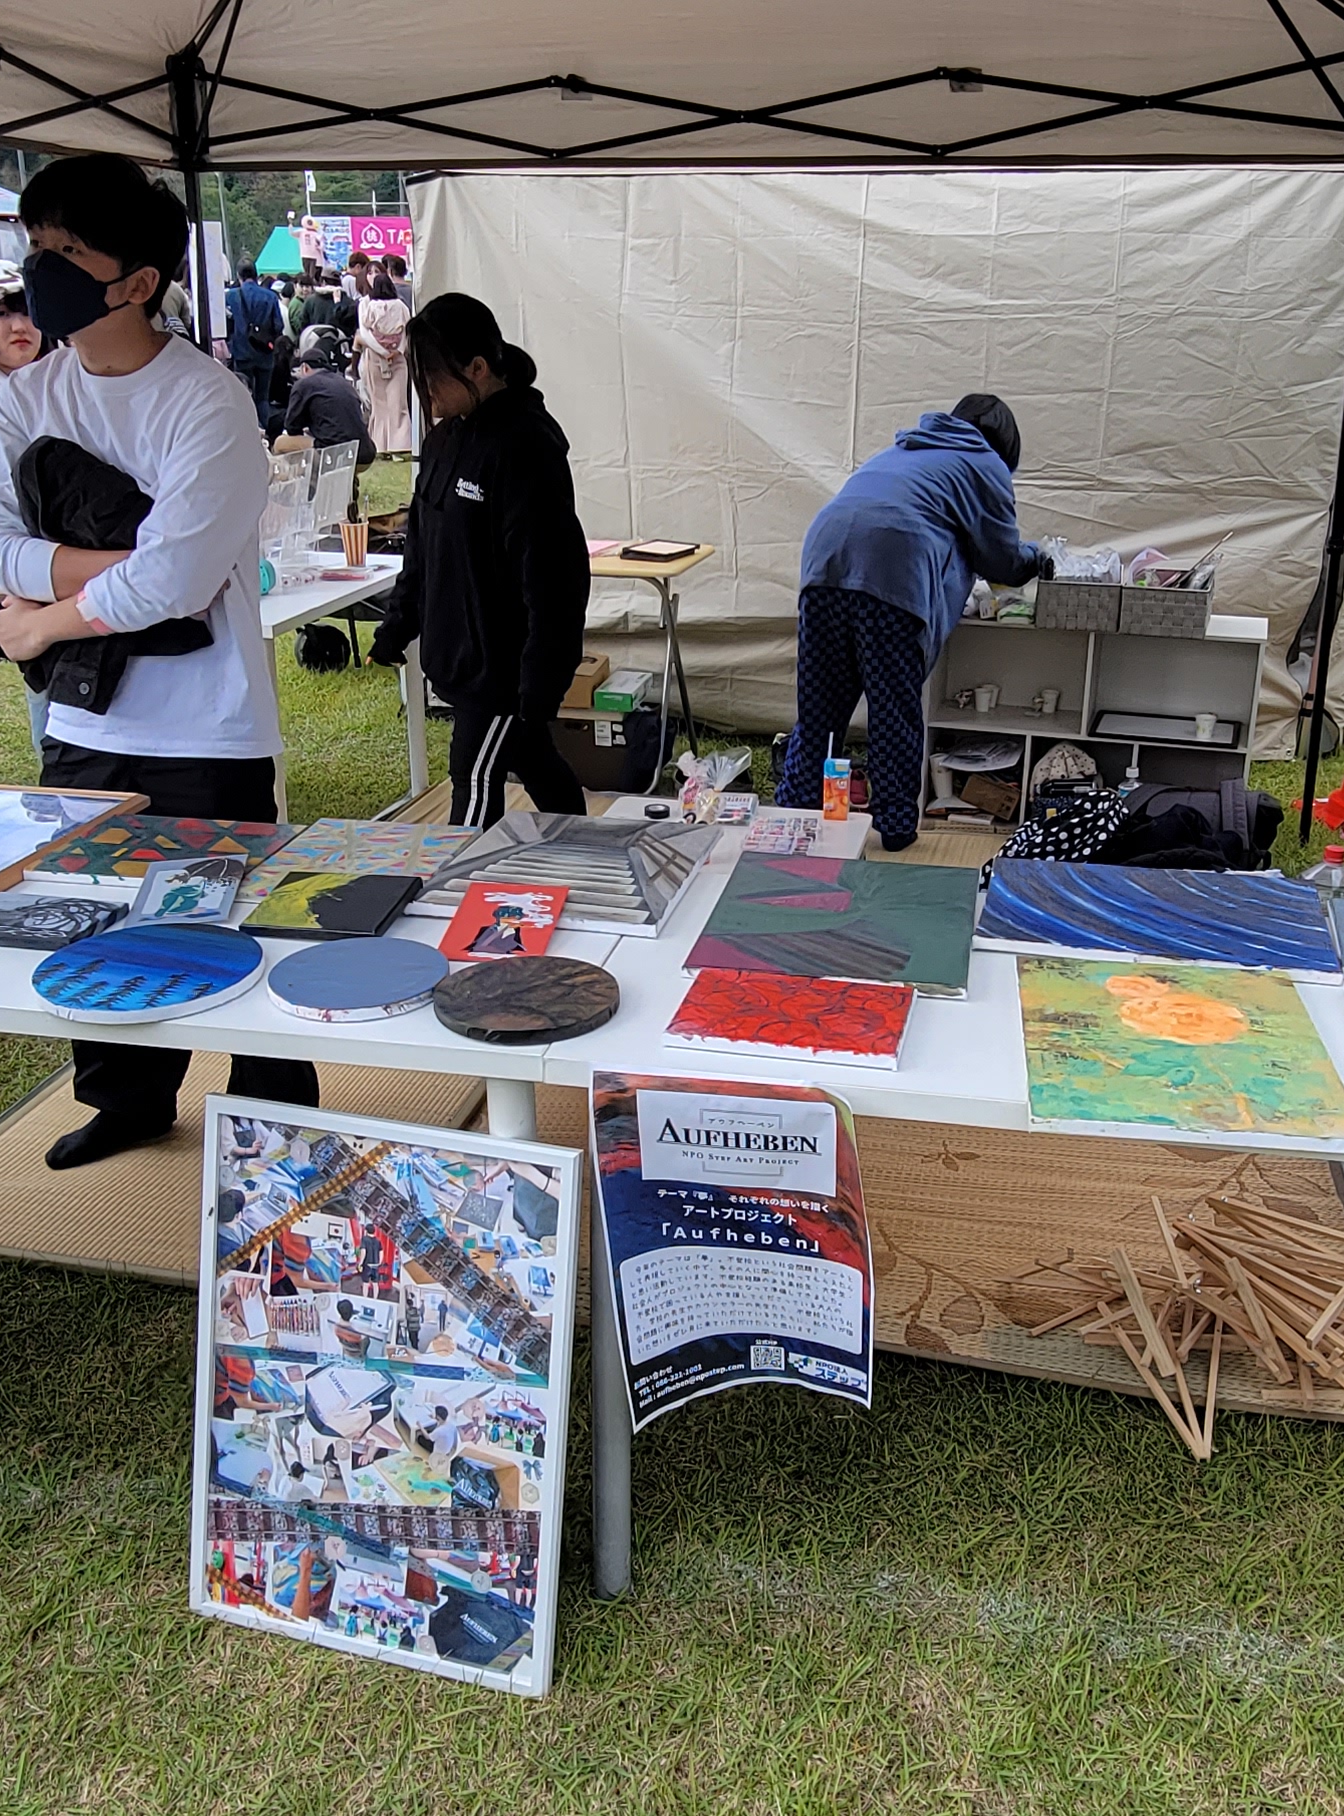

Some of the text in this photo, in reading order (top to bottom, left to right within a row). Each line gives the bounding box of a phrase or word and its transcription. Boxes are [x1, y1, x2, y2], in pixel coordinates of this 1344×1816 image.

[657, 1117, 821, 1154] AUFHEBEN
[682, 1150, 704, 1160] NPO
[758, 1156, 800, 1166] PROJECT
[682, 1204, 797, 1226] アートプロジェクト
[815, 1367, 864, 1387] ステップ
